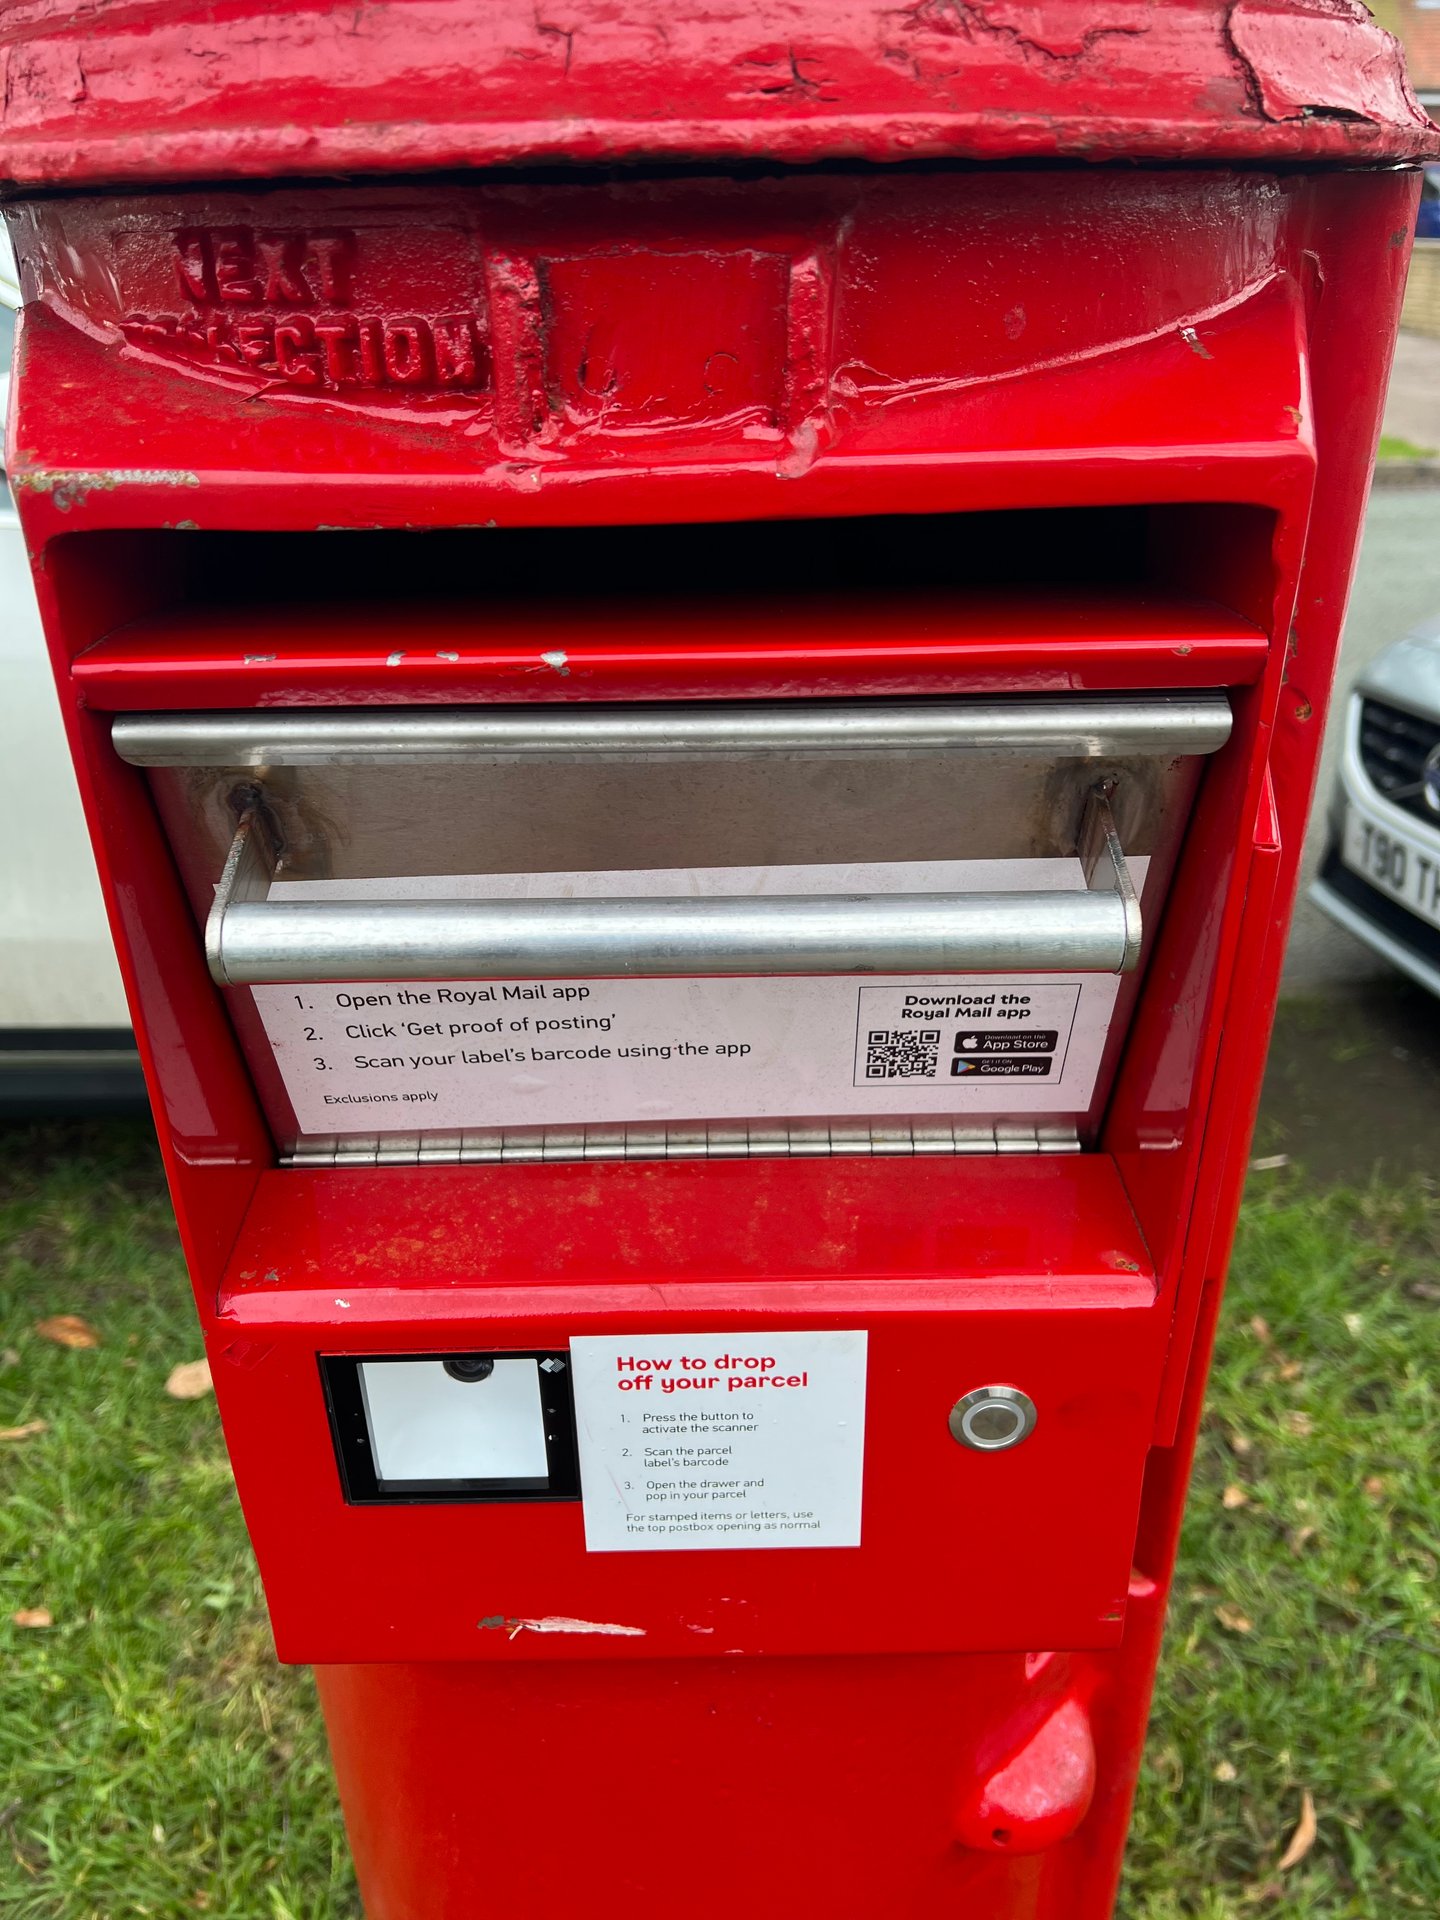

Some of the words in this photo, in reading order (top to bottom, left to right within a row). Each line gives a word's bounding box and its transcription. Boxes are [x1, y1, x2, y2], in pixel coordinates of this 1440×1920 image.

[295, 995, 313, 1009] 1.
[336, 993, 391, 1010] Open
[397, 989, 431, 1004] the
[437, 986, 497, 1005] Royal
[502, 984, 546, 1000] Mail
[553, 986, 589, 1001] app
[905, 993, 995, 1005] Download
[1001, 993, 1030, 1004] the
[902, 1007, 950, 1020] Royal
[955, 1006, 992, 1017] Mail
[997, 1008, 1030, 1019] app
[304, 1026, 323, 1040] 2.
[346, 1023, 396, 1038] Click
[449, 1017, 503, 1037] proof
[510, 1016, 529, 1031] of
[982, 1040, 1011, 1051] App
[1013, 1039, 1049, 1049] Store
[314, 1057, 332, 1070] 3.
[355, 1055, 404, 1068] Scan
[409, 1055, 455, 1069] your
[531, 1044, 611, 1060] barcode
[618, 1043, 671, 1059] using
[675, 1041, 708, 1055] the
[716, 1043, 751, 1057] app
[980, 1064, 1020, 1074] Google
[1021, 1064, 1045, 1074] Play
[324, 1094, 398, 1104] Exclusions
[403, 1090, 438, 1102] apply
[617, 1356, 672, 1371] How
[680, 1356, 707, 1371] to
[714, 1354, 776, 1372] drop
[617, 1375, 654, 1391] off
[661, 1374, 720, 1393] your
[727, 1372, 808, 1392] parcel
[621, 1414, 630, 1423] 1.
[643, 1413, 676, 1423] Press
[679, 1412, 698, 1422] the
[701, 1412, 740, 1421] button
[742, 1412, 754, 1421] to
[642, 1424, 688, 1434] activate
[691, 1424, 709, 1433] the
[712, 1423, 759, 1432] scanner
[622, 1448, 632, 1457] 2.
[644, 1448, 673, 1457] Scan
[676, 1447, 694, 1456] the
[697, 1445, 732, 1457] parcel
[683, 1457, 729, 1467] barcode
[624, 1481, 634, 1490] 3.
[646, 1480, 676, 1492] Open
[679, 1479, 698, 1489] the
[700, 1479, 741, 1489] drawer
[743, 1478, 765, 1487] and
[646, 1491, 667, 1502] pop
[670, 1490, 681, 1500] in
[683, 1490, 710, 1501] your
[712, 1489, 747, 1500] parcel
[626, 1512, 646, 1522] For
[649, 1511, 698, 1523] stamped
[700, 1510, 733, 1521] items
[735, 1511, 749, 1520] or
[751, 1510, 790, 1520] letters,
[793, 1510, 814, 1519] use
[627, 1523, 645, 1533] the
[648, 1523, 667, 1534] top
[669, 1521, 714, 1533] postbox
[716, 1520, 761, 1532] opening
[764, 1520, 778, 1530] as
[780, 1519, 821, 1530] normal
